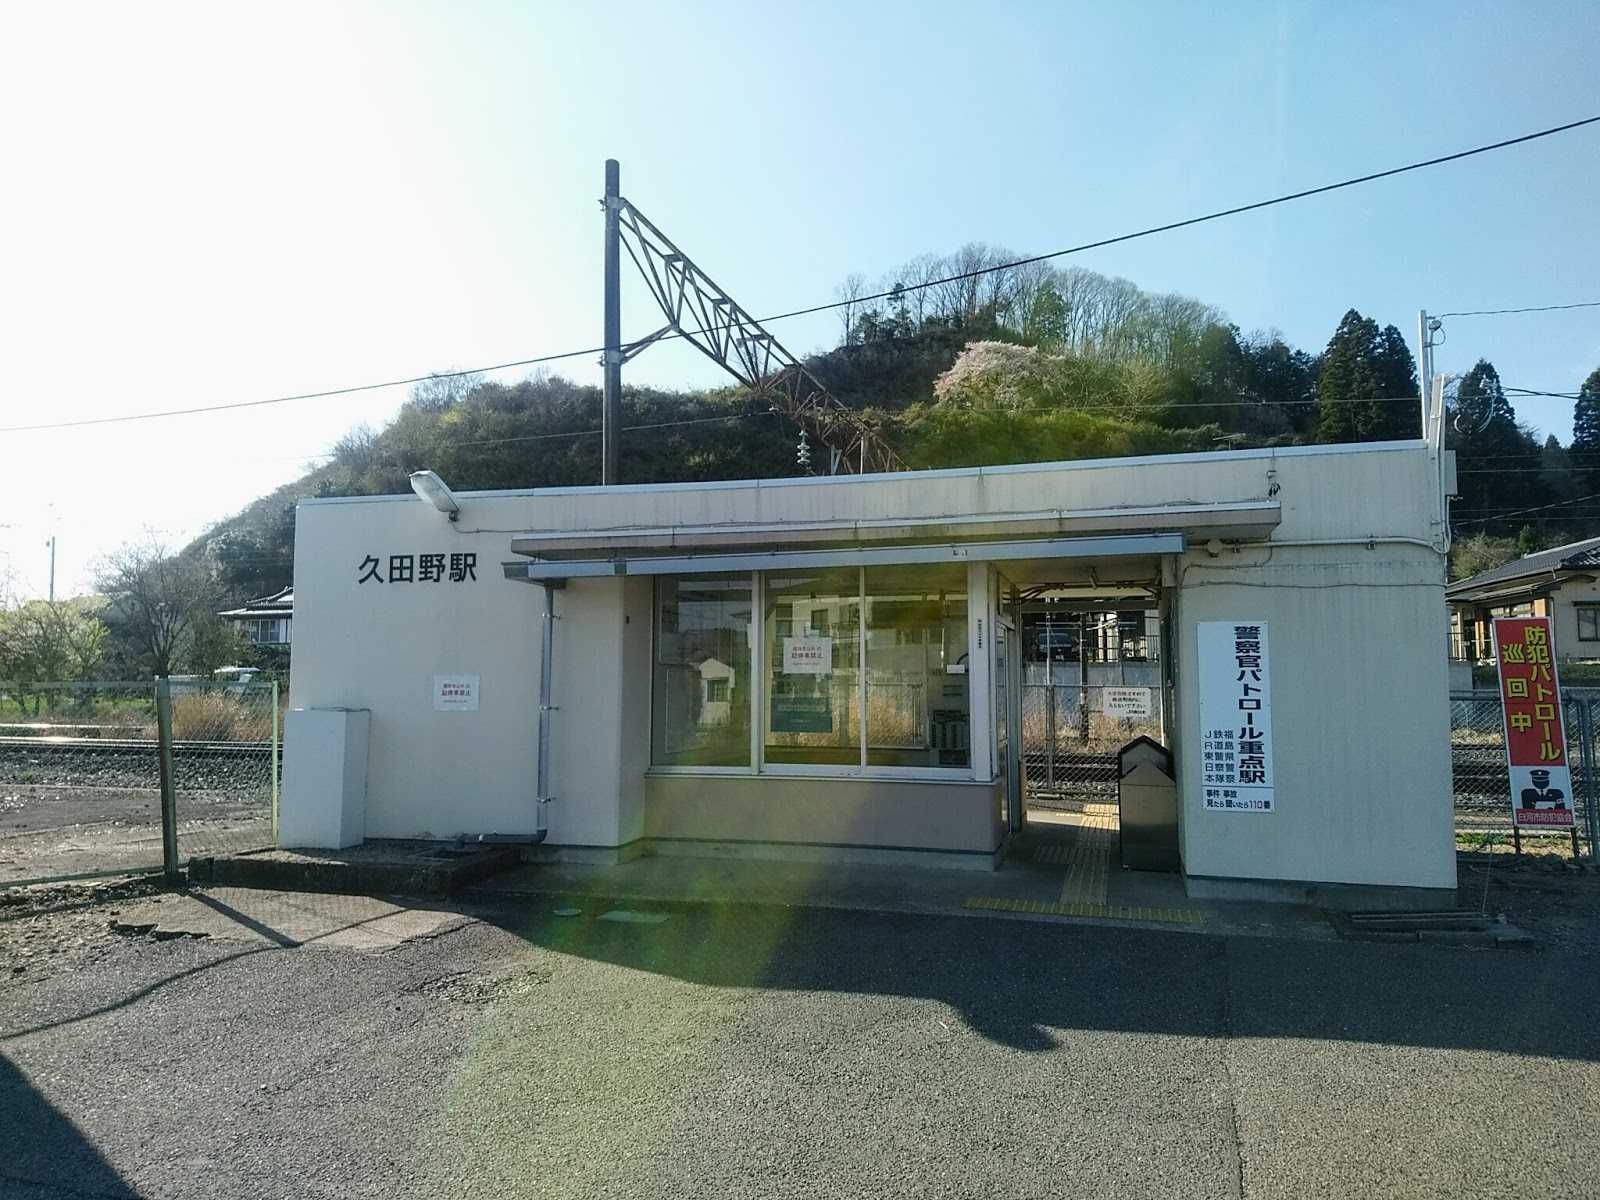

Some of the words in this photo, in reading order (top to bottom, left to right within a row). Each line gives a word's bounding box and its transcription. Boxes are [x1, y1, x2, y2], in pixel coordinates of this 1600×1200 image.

[358, 553, 476, 584] 久田野駅
[1234, 626, 1266, 783] 警察官パトロール重点駅
[1502, 643, 1533, 733] 巡回中
[1525, 626, 1561, 761] 防犯パトロール
[1204, 730, 1214, 783] JR東日本
[1213, 730, 1225, 783] 鉄道警察隊
[1224, 730, 1234, 783] 福島県警察
[1206, 789, 1220, 798] 事件
[1223, 790, 1238, 798] 事故
